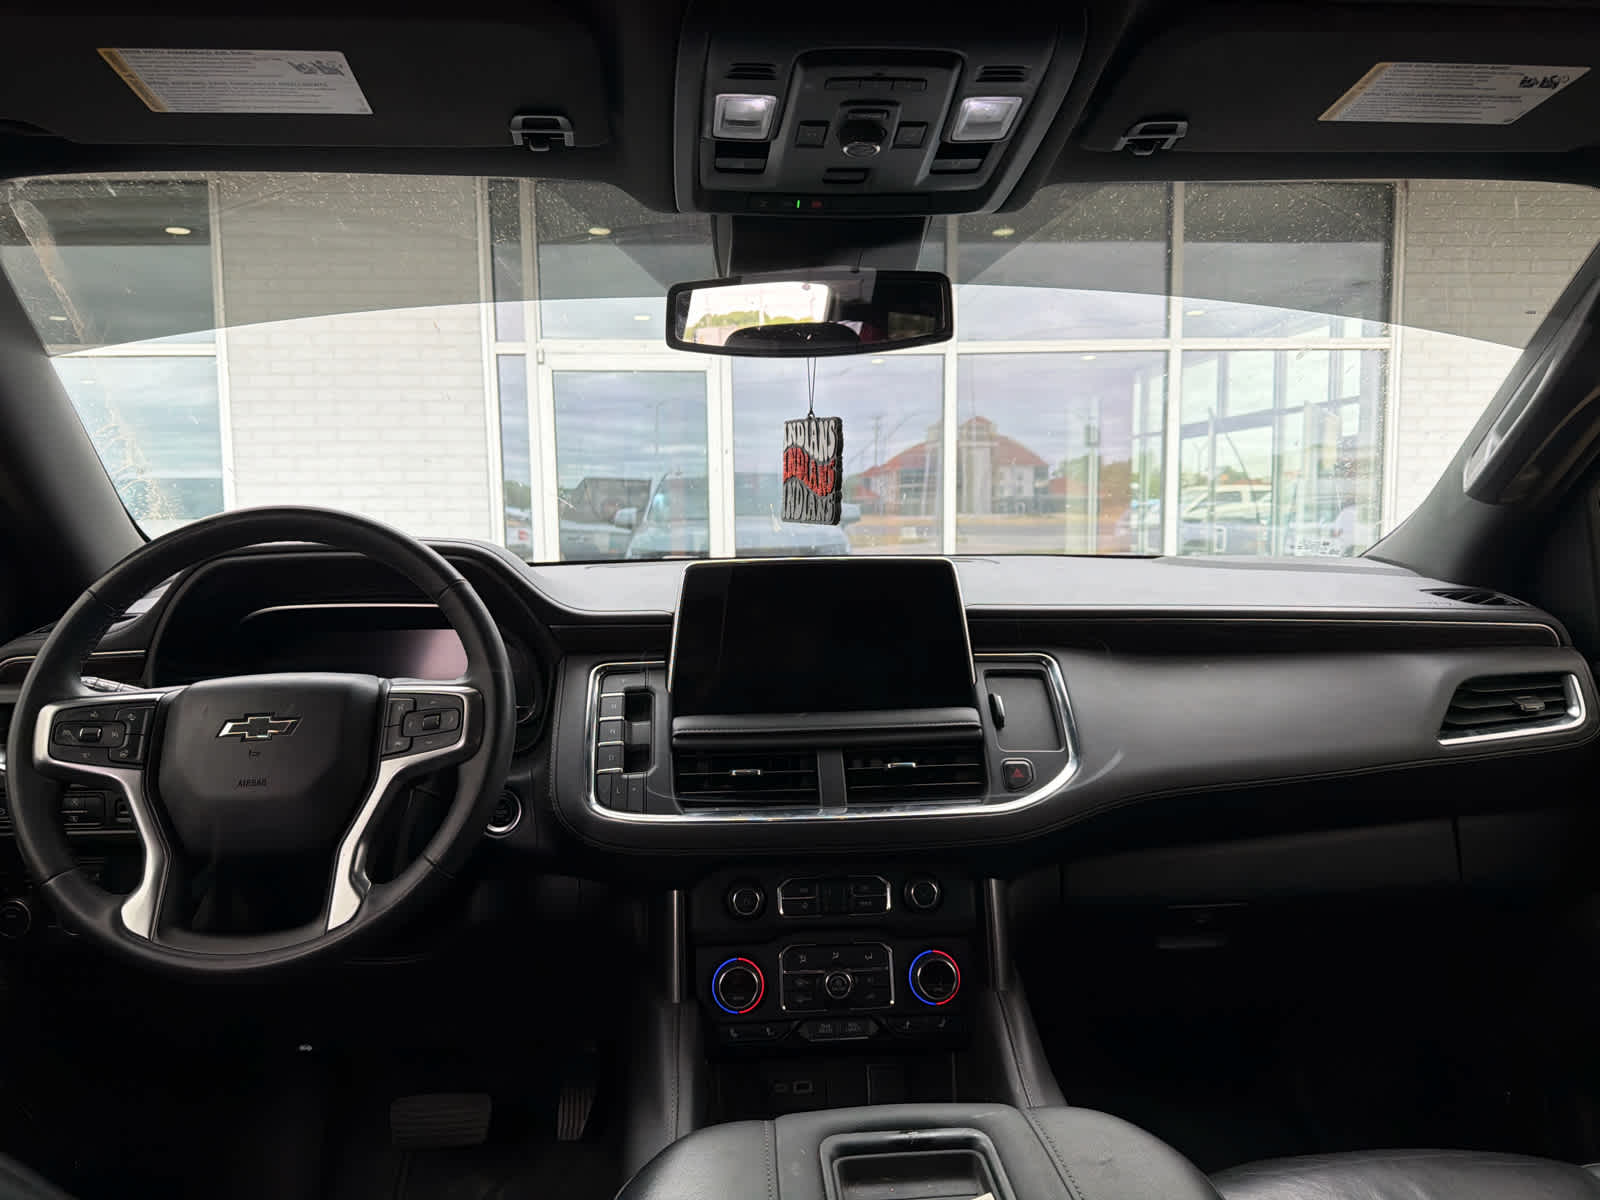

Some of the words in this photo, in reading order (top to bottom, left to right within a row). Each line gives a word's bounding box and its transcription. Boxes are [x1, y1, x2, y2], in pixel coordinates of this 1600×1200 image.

[784, 420, 836, 461] INDIANS
[783, 447, 835, 496] INDIANS
[783, 479, 834, 521] INDIANS
